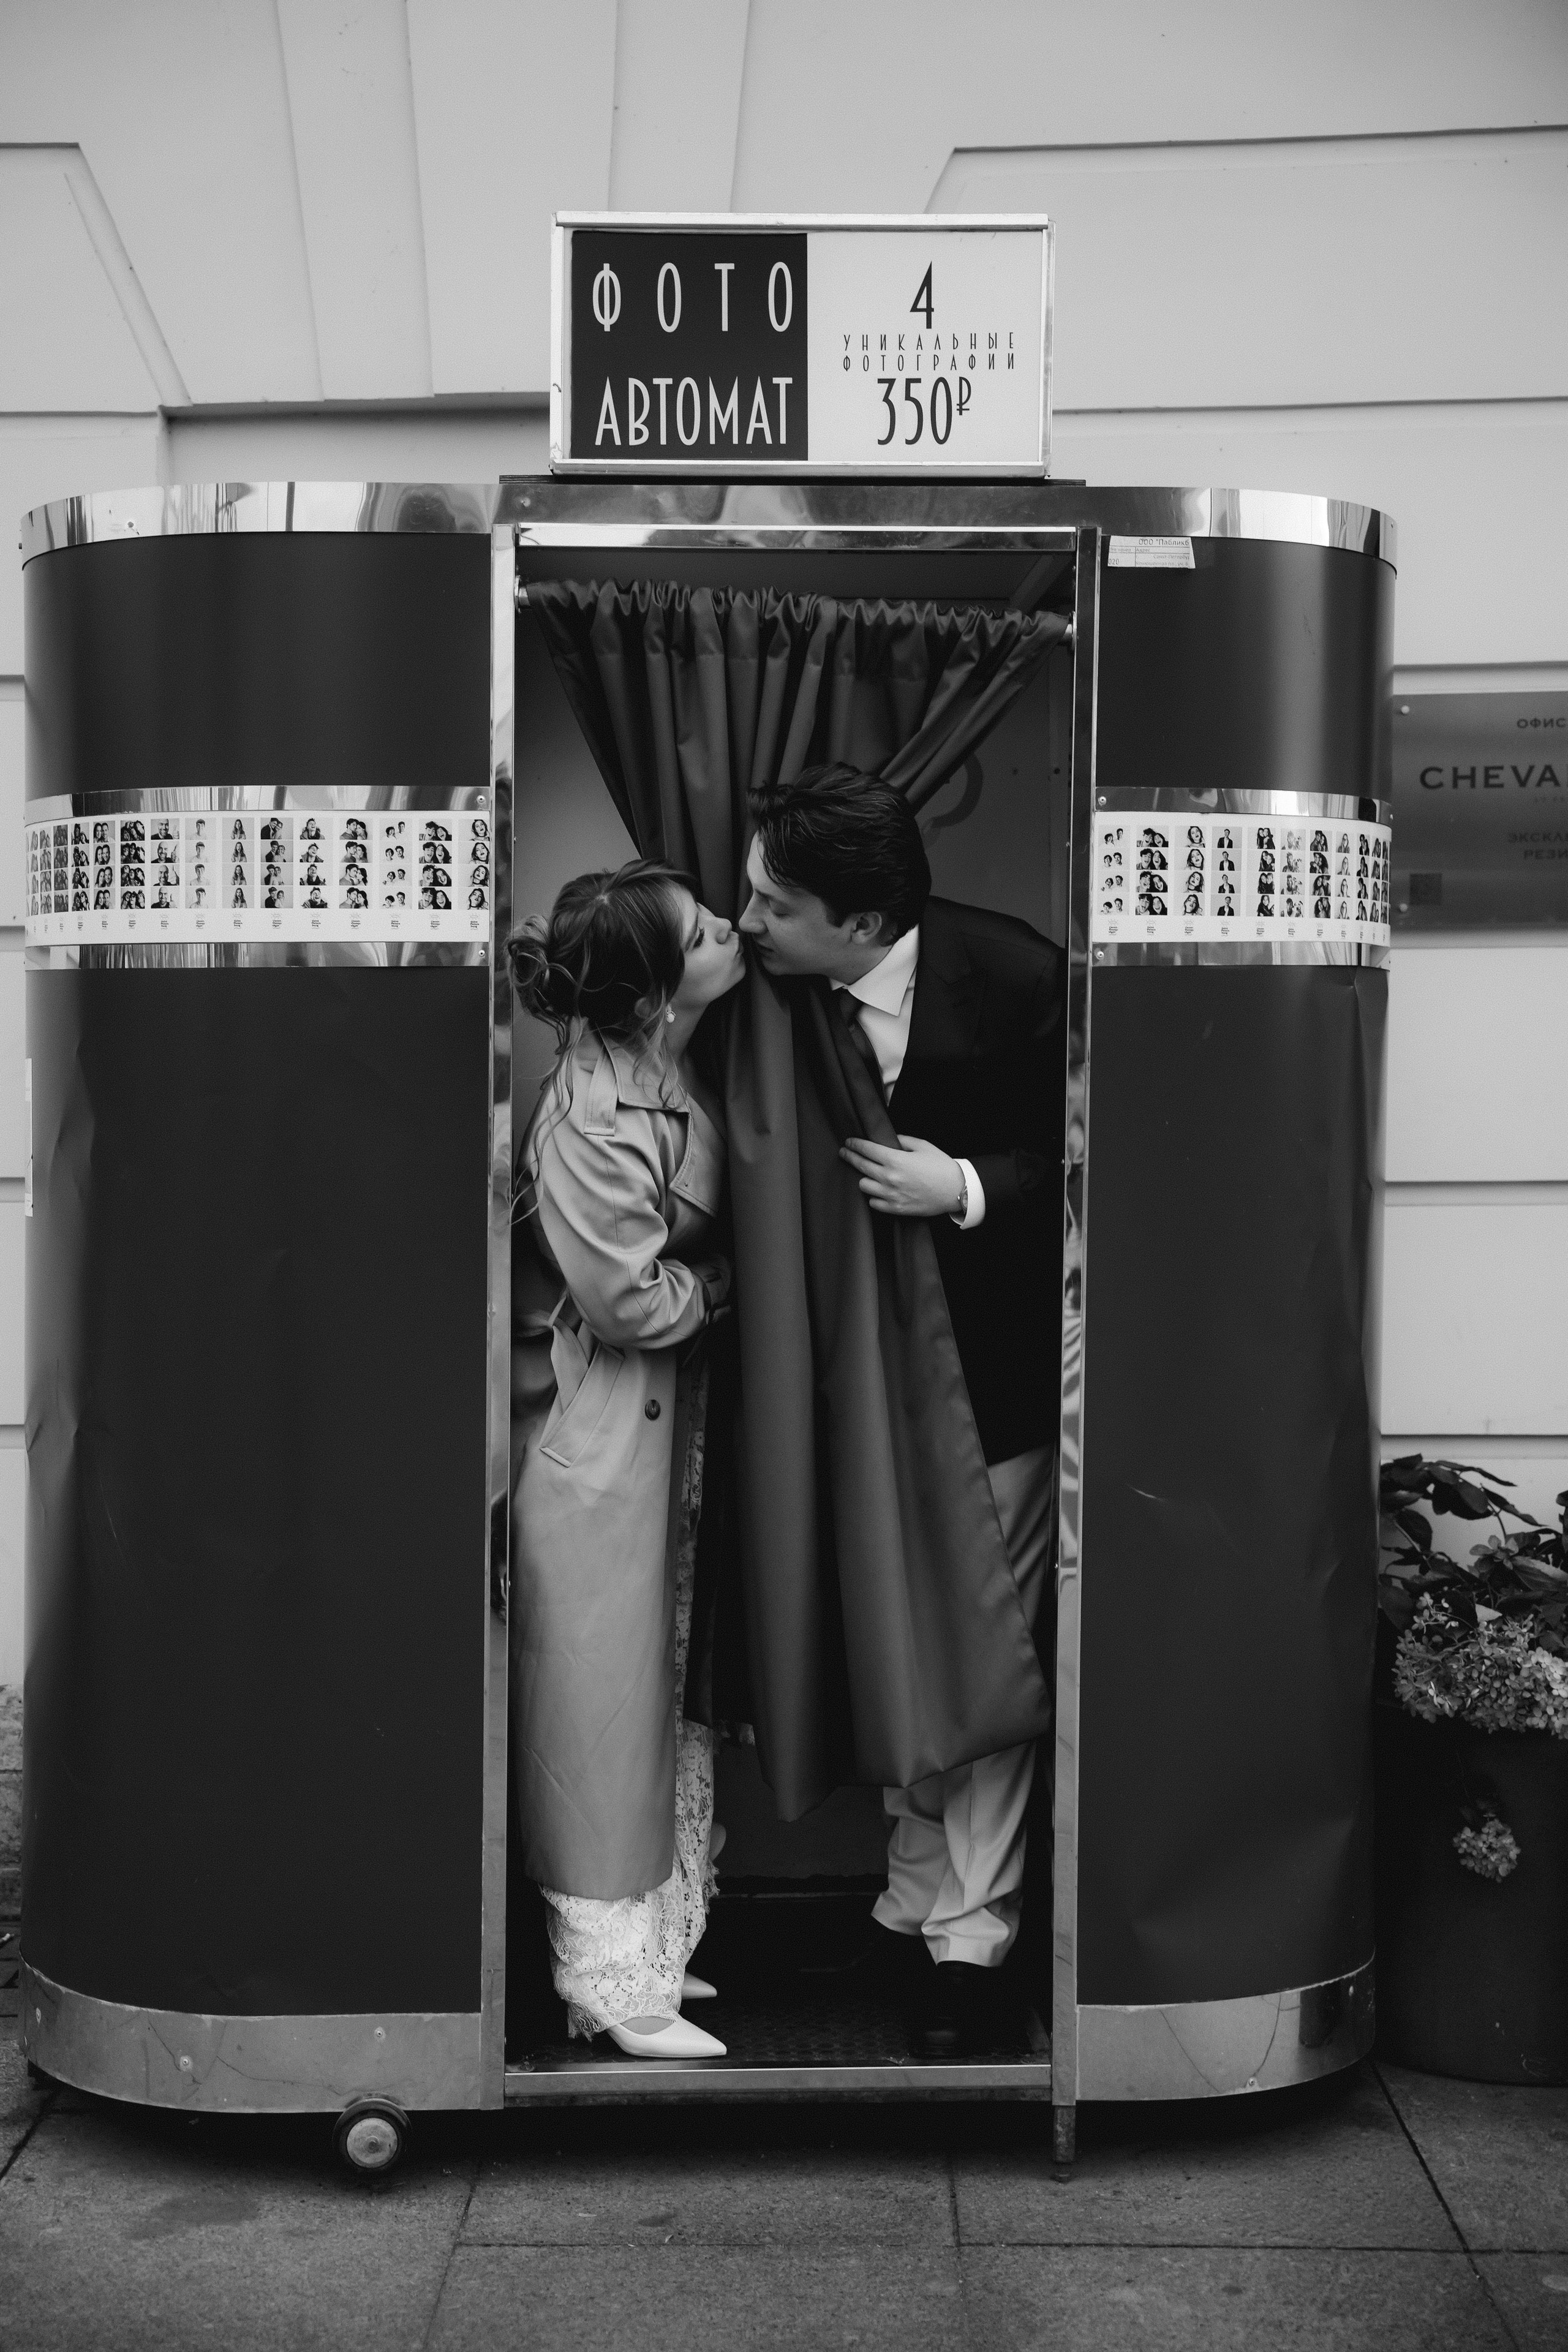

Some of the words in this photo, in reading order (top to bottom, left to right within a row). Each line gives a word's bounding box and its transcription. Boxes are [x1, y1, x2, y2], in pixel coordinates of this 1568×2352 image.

[592, 262, 793, 333] ФОТО
[910, 260, 935, 330] 4
[843, 332, 1015, 352] УНИКАЛЬНЫЕ
[843, 353, 1015, 372] ФОТОГРАФИИ
[594, 376, 793, 447] АВТОМАТ
[1419, 764, 1568, 790] CHEVA
